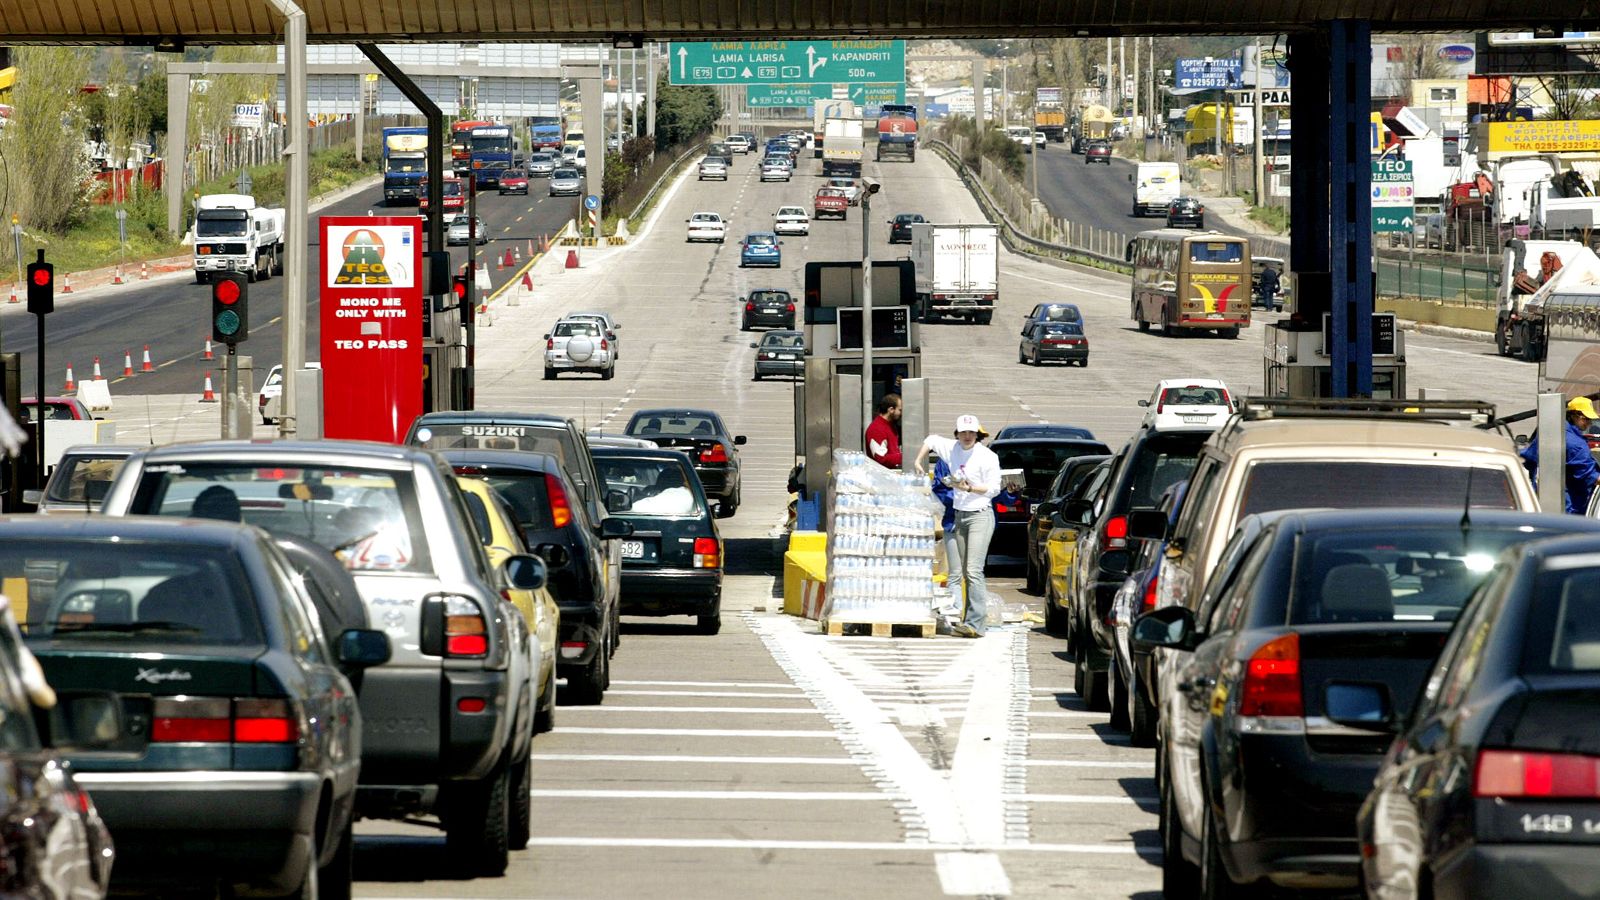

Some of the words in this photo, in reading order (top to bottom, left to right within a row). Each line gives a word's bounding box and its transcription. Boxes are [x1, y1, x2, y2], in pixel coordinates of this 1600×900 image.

[712, 53, 744, 63] LAMIA
[749, 53, 785, 62] LARISA
[832, 52, 891, 61] KAPANDRITI
[848, 68, 866, 77] 500
[1376, 160, 1406, 172] ΤΕΟ
[343, 263, 385, 273] TEO
[336, 276, 391, 284] PASS
[340, 298, 379, 306] ΜΟΝΟ
[382, 297, 402, 306] ΜΕ
[335, 309, 368, 318] ONLY
[373, 309, 407, 318] WITH
[334, 340, 364, 349] TEO
[367, 339, 408, 349] PASS
[461, 426, 526, 437] SUZUKI
